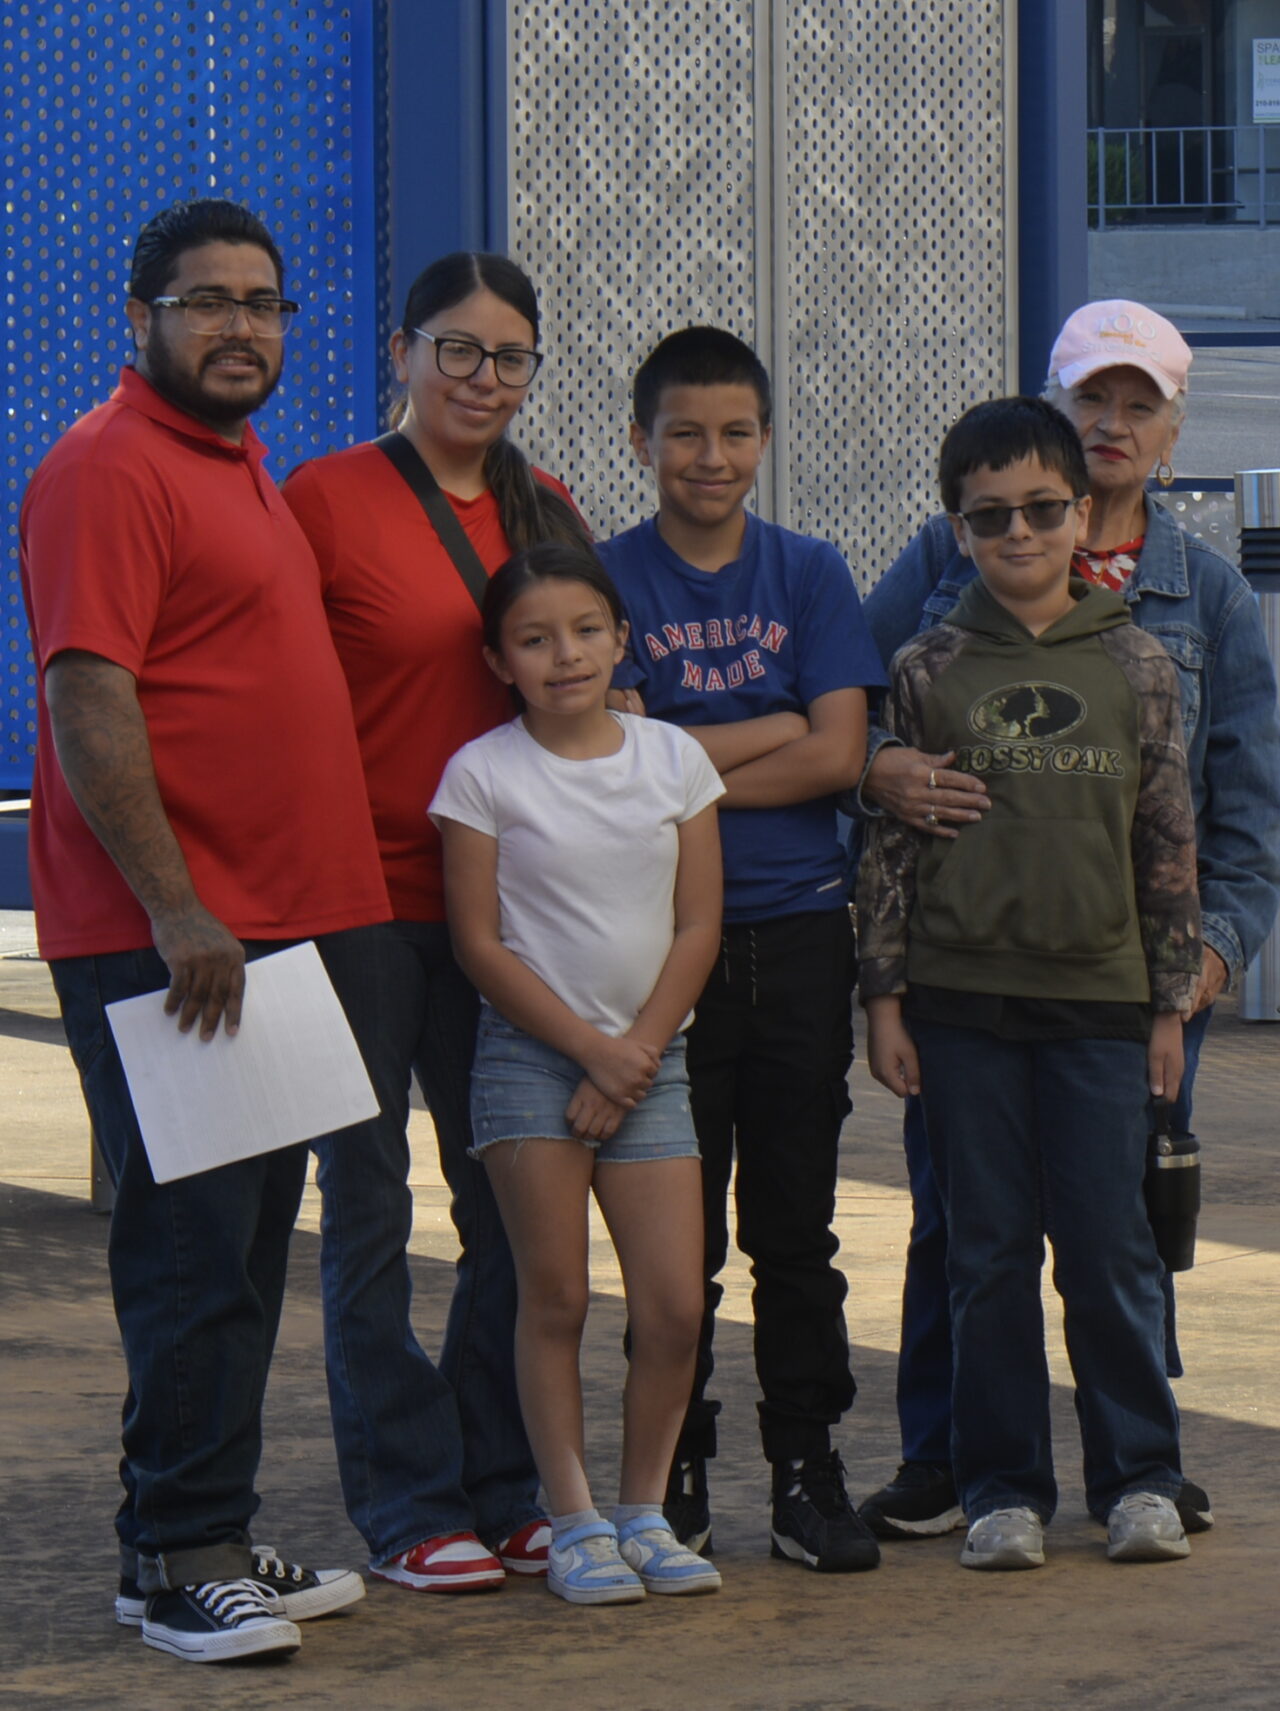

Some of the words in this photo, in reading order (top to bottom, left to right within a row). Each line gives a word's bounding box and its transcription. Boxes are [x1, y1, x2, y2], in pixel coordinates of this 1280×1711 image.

[645, 614, 788, 662] AMERICAN
[681, 650, 765, 691] MADE
[1053, 746, 1120, 776] OAK
